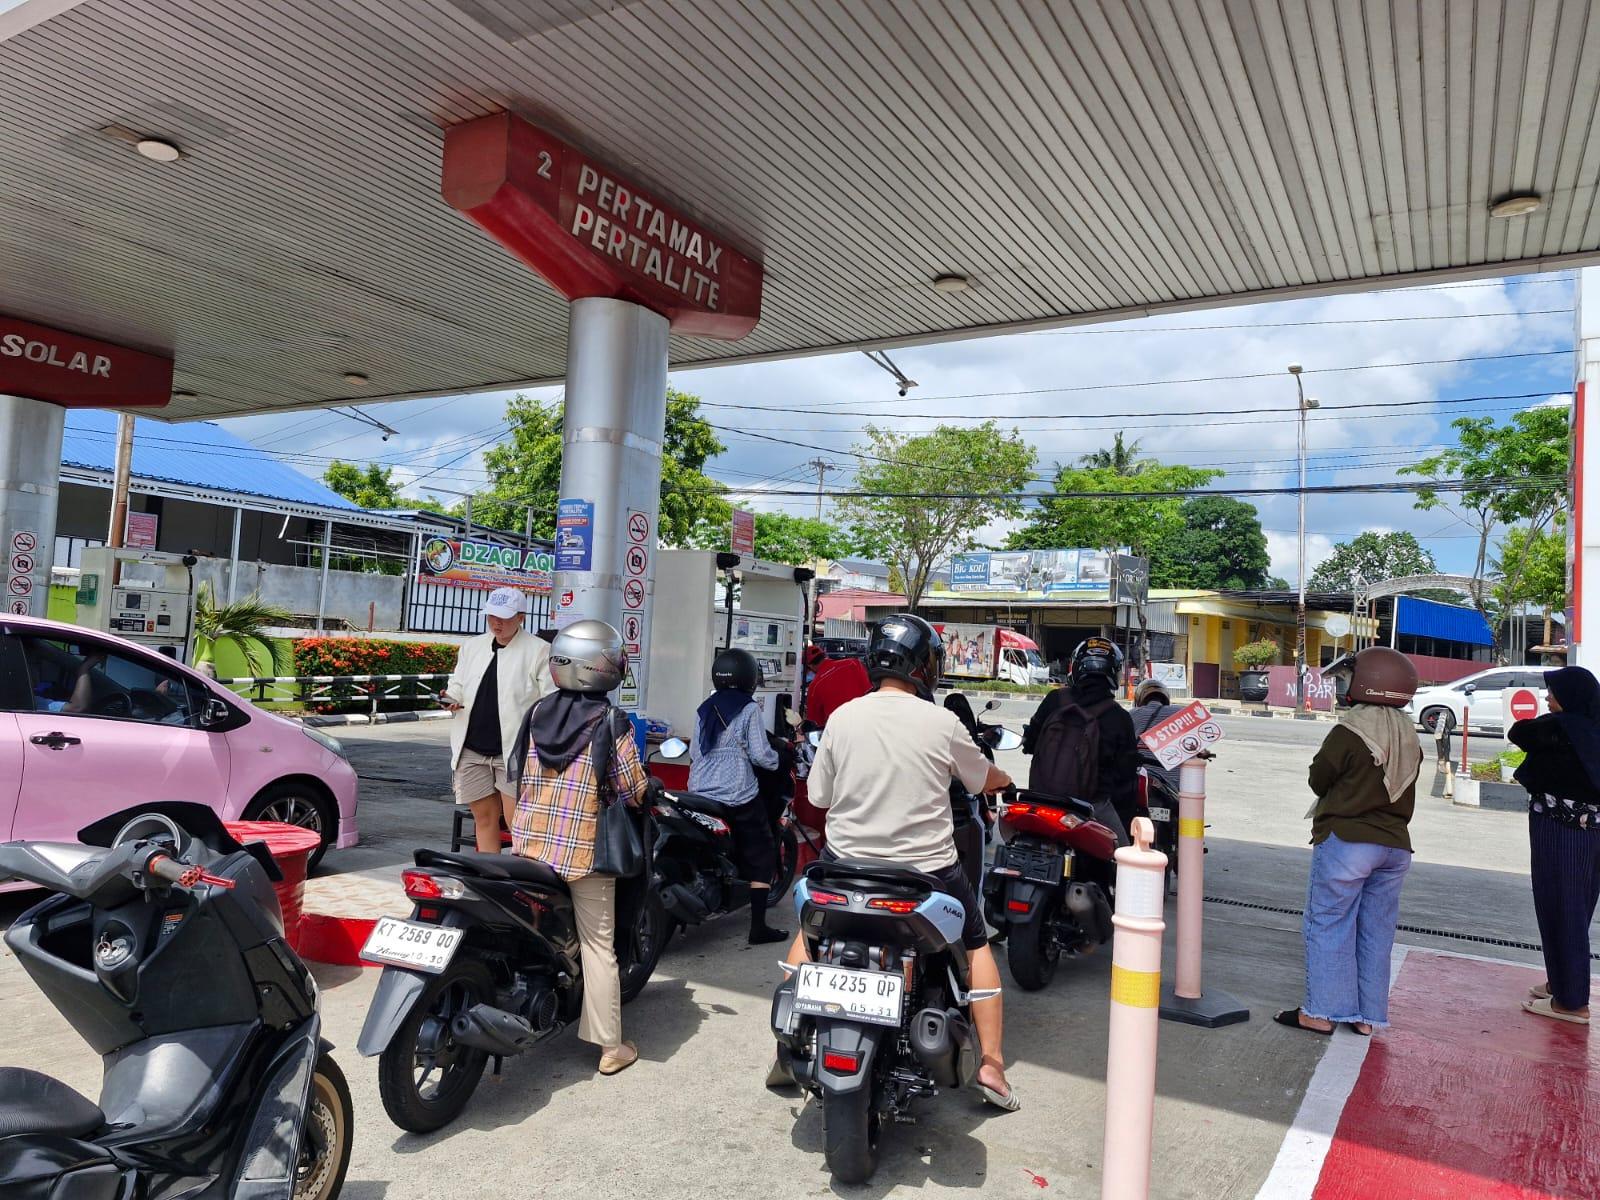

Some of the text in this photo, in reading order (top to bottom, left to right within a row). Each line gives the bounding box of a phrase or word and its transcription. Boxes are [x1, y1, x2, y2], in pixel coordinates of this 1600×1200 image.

[537, 150, 722, 275] 2 PERTAMAX
[571, 203, 720, 310] PERTALITE
[0, 334, 112, 378] SOLAR
[460, 541, 521, 569] DZAQI
[1155, 712, 1195, 741] STOP!!!
[377, 921, 397, 937] KT
[398, 926, 433, 944] 2569
[803, 970, 896, 997] KT 4235 QP
